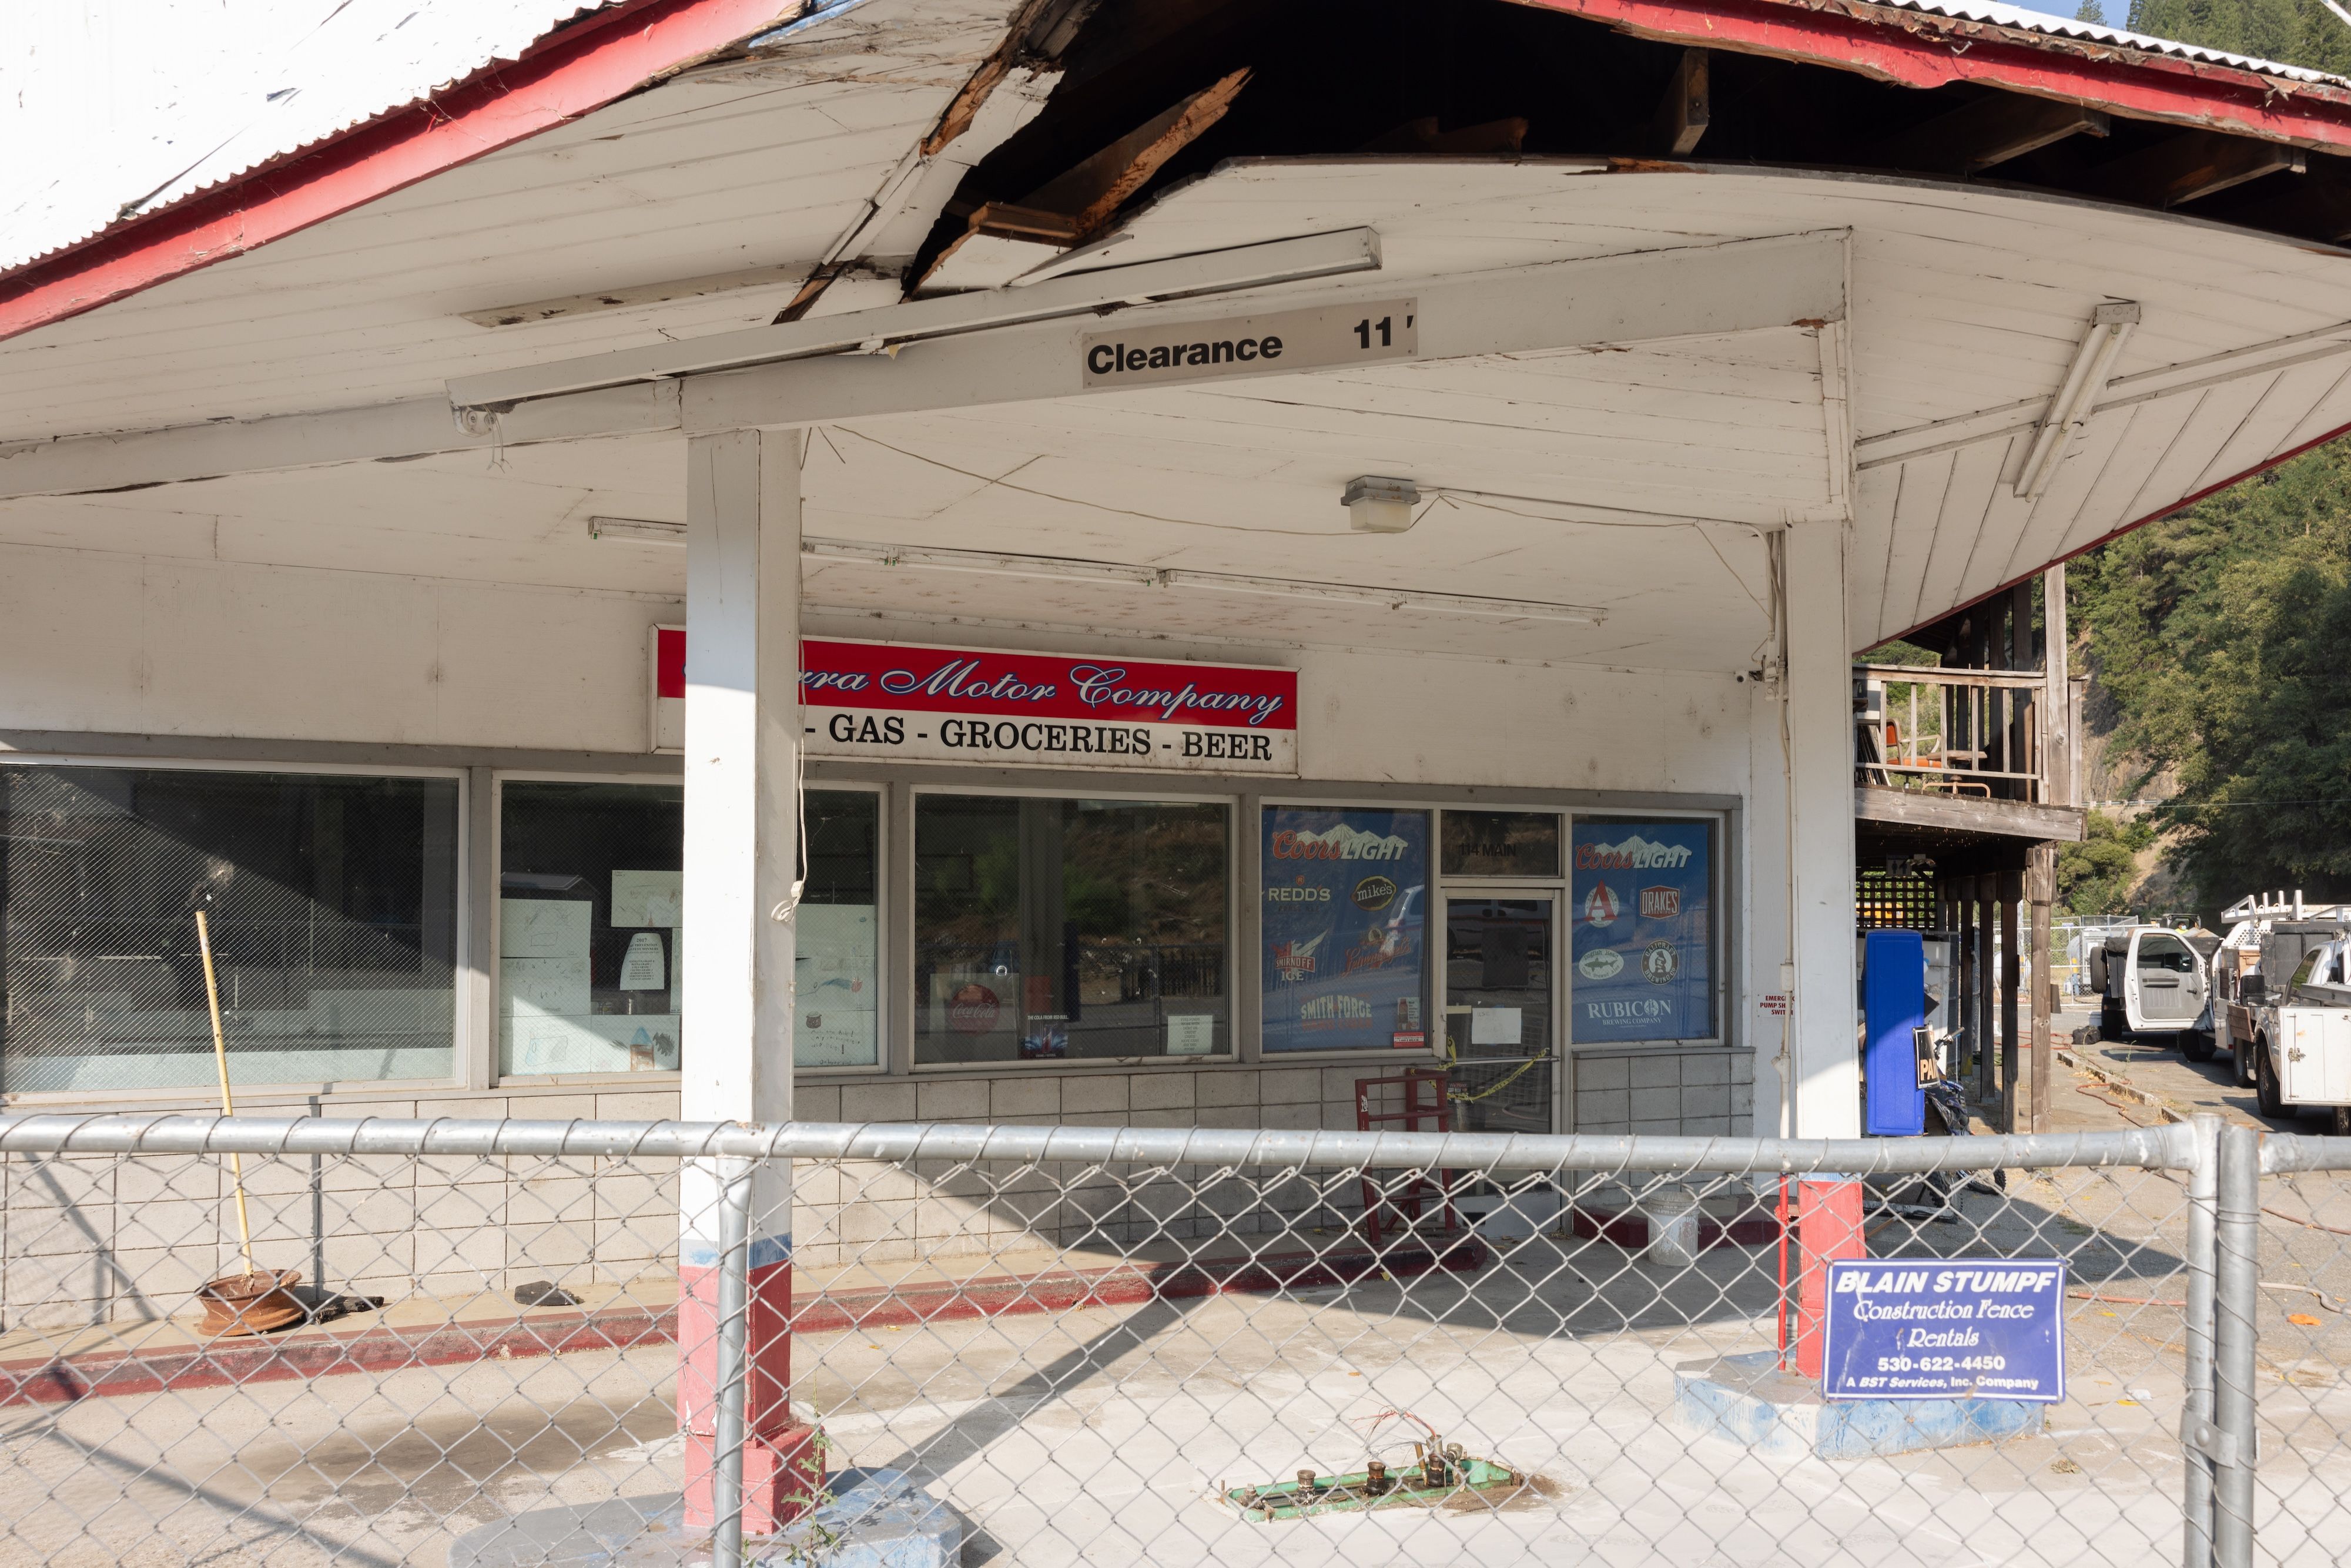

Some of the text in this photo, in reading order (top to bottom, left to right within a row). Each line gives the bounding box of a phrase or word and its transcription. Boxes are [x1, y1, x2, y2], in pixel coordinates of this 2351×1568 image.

[1087, 336, 1282, 374] Clearance
[879, 656, 1055, 701] Motor
[1069, 664, 1284, 726] Company
[829, 713, 905, 745] GAS
[940, 719, 1151, 755] GROCERIES
[1182, 731, 1272, 761] BEER
[1272, 830, 1408, 860] Coors LIGHT
[1461, 843, 1516, 856] 114 MAIN
[1575, 843, 1692, 870] Coors LIGHT
[1357, 883, 1392, 902] mike's
[1642, 891, 1677, 914] DRAKE'S
[1584, 950, 1619, 960] Dogfish Head
[1645, 942, 1676, 957] CALICRAFT
[1276, 957, 1311, 969] SMIRNOFF
[1281, 971, 1304, 981] ICE
[1645, 969, 1670, 983] BREWING
[1301, 994, 1372, 1019] SMITH FORGE
[1586, 999, 1672, 1018] RUBICON
[1835, 1271, 2057, 1293] BLAIN STUMPF
[1853, 1298, 2034, 1320] Construction Fence
[1907, 1326, 1980, 1348] Rentals
[1877, 1355, 2005, 1372] 530-622-4450
[1846, 1376, 2039, 1390] A BST Services, Inc. Company
